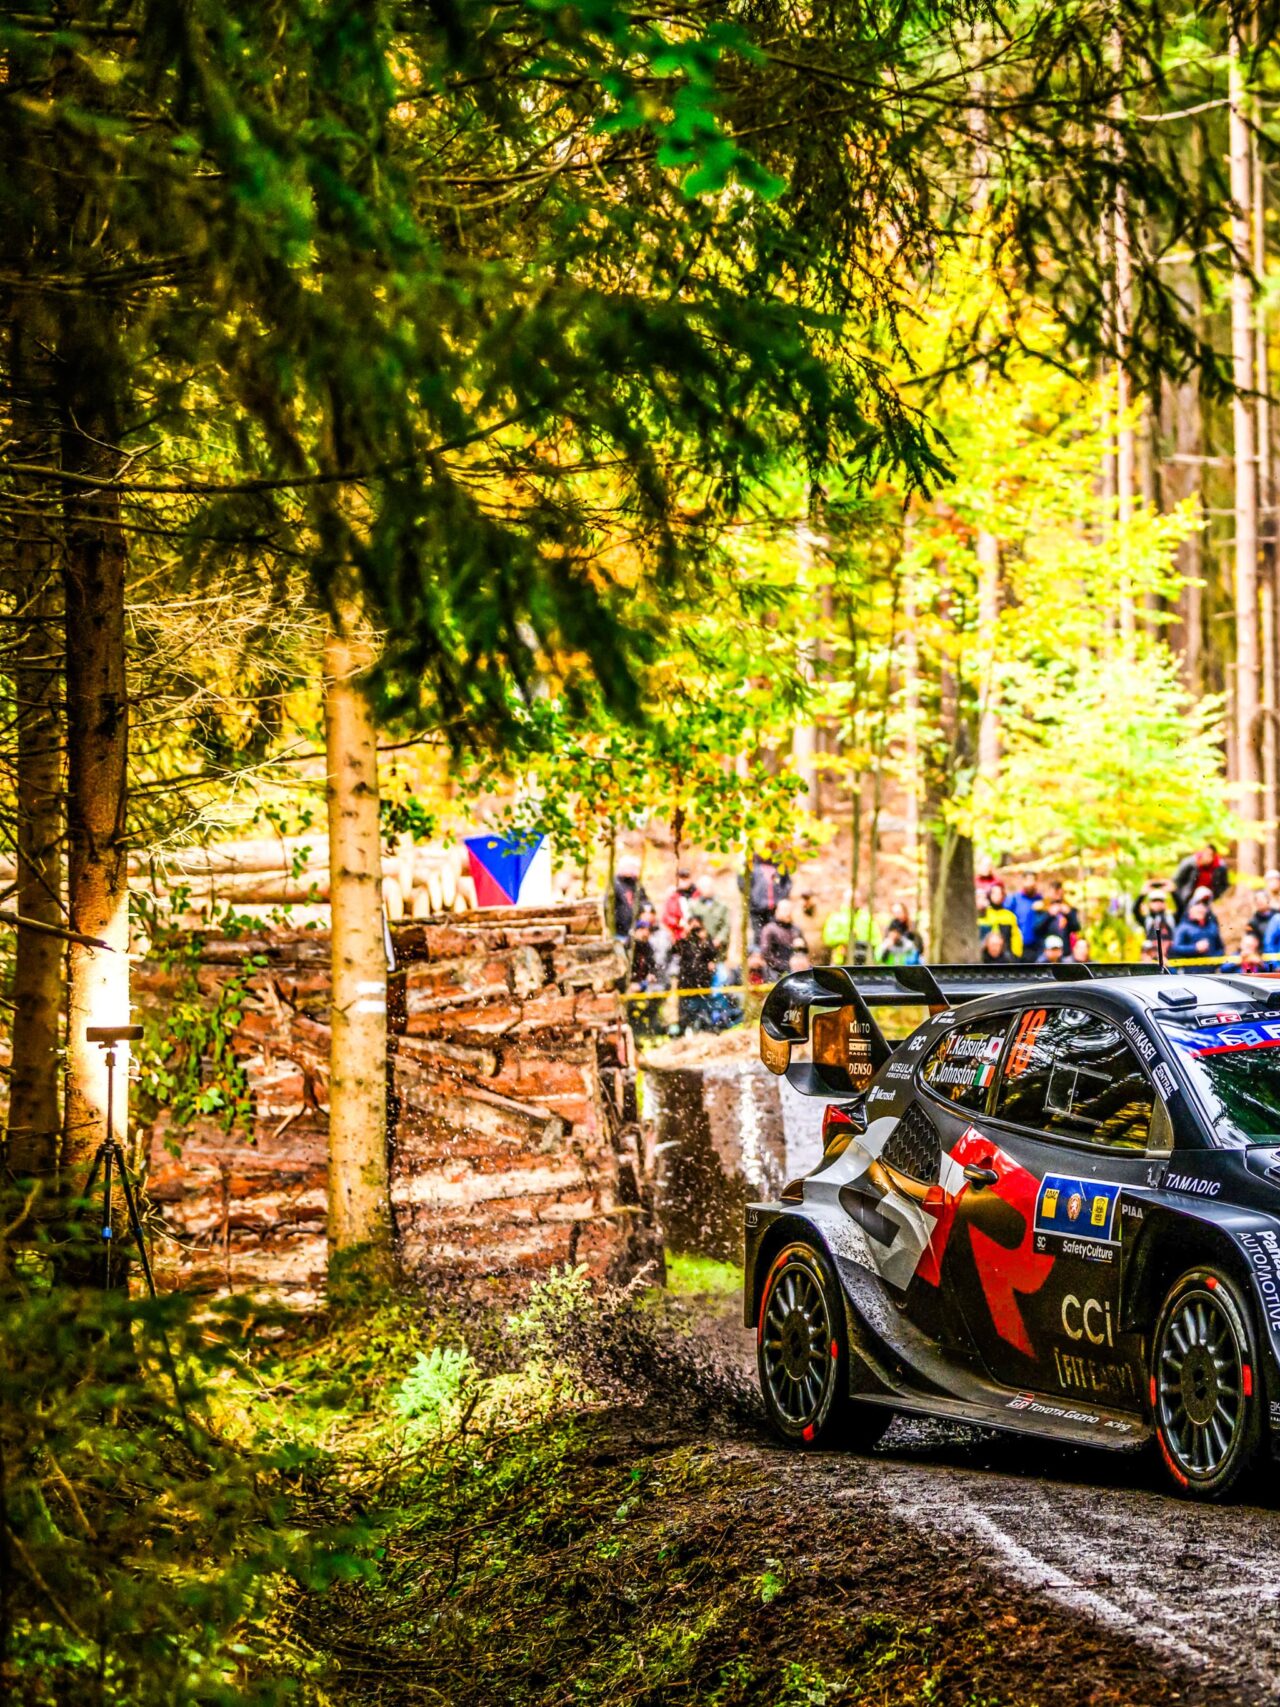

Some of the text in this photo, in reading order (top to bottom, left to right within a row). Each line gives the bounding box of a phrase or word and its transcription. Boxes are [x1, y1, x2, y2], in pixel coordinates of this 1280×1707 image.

[1200, 1013, 1240, 1025] GR
[848, 1062, 872, 1076] DENSO
[888, 1062, 914, 1074] NISULA
[928, 1062, 977, 1085] A.Johnston
[1154, 1064, 1174, 1097] CENTRAL
[1165, 1173, 1221, 1195] TAMADIC
[1121, 1204, 1144, 1219] PIAA
[1036, 1236, 1046, 1248] SC
[1062, 1240, 1113, 1260] SafetyCulture
[1028, 1402, 1064, 1416] TOYOTA
